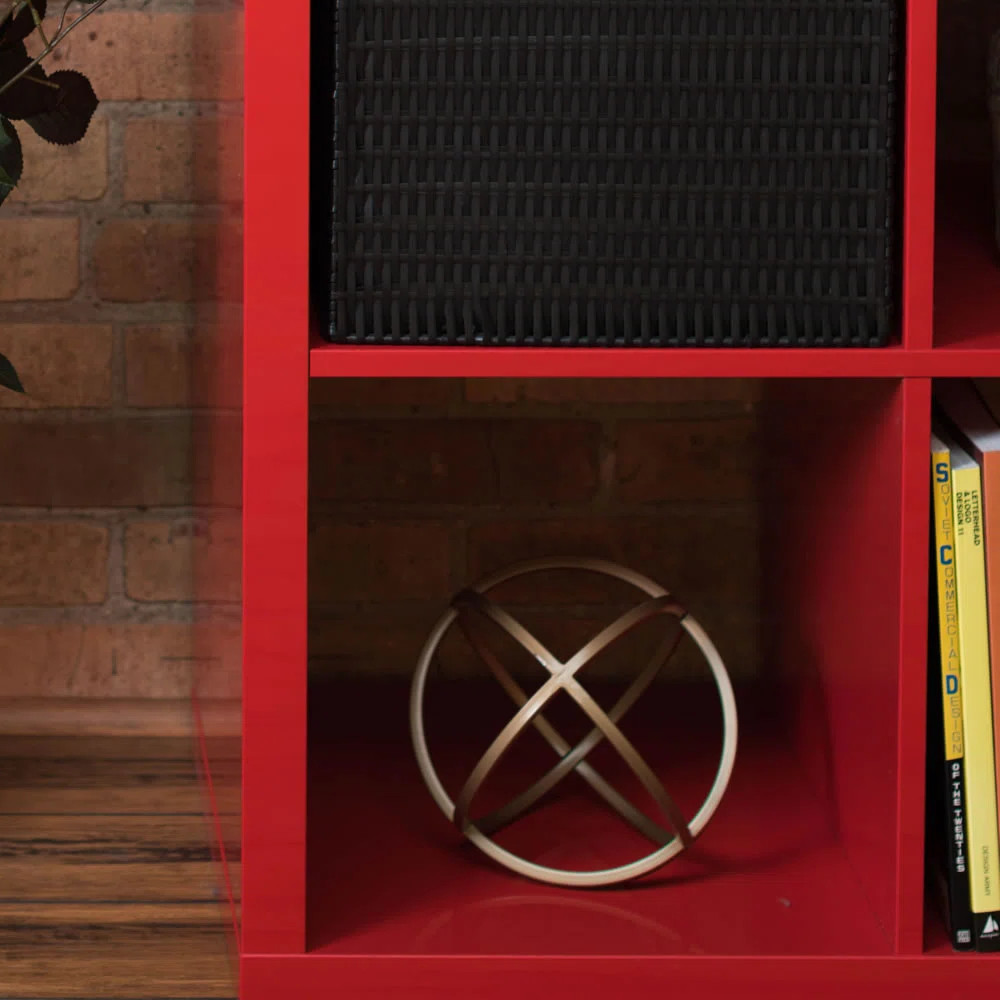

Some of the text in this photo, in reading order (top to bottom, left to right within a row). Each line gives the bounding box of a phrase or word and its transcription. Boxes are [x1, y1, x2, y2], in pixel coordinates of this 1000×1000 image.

[956, 491, 964, 525] DESIGN
[964, 499, 972, 524] LOGO
[971, 489, 981, 546] LETTERHEAD
[935, 462, 962, 753] SOVIET COMMERCIAL DESIGN
[952, 763, 965, 873] OF THE TWENTIES
